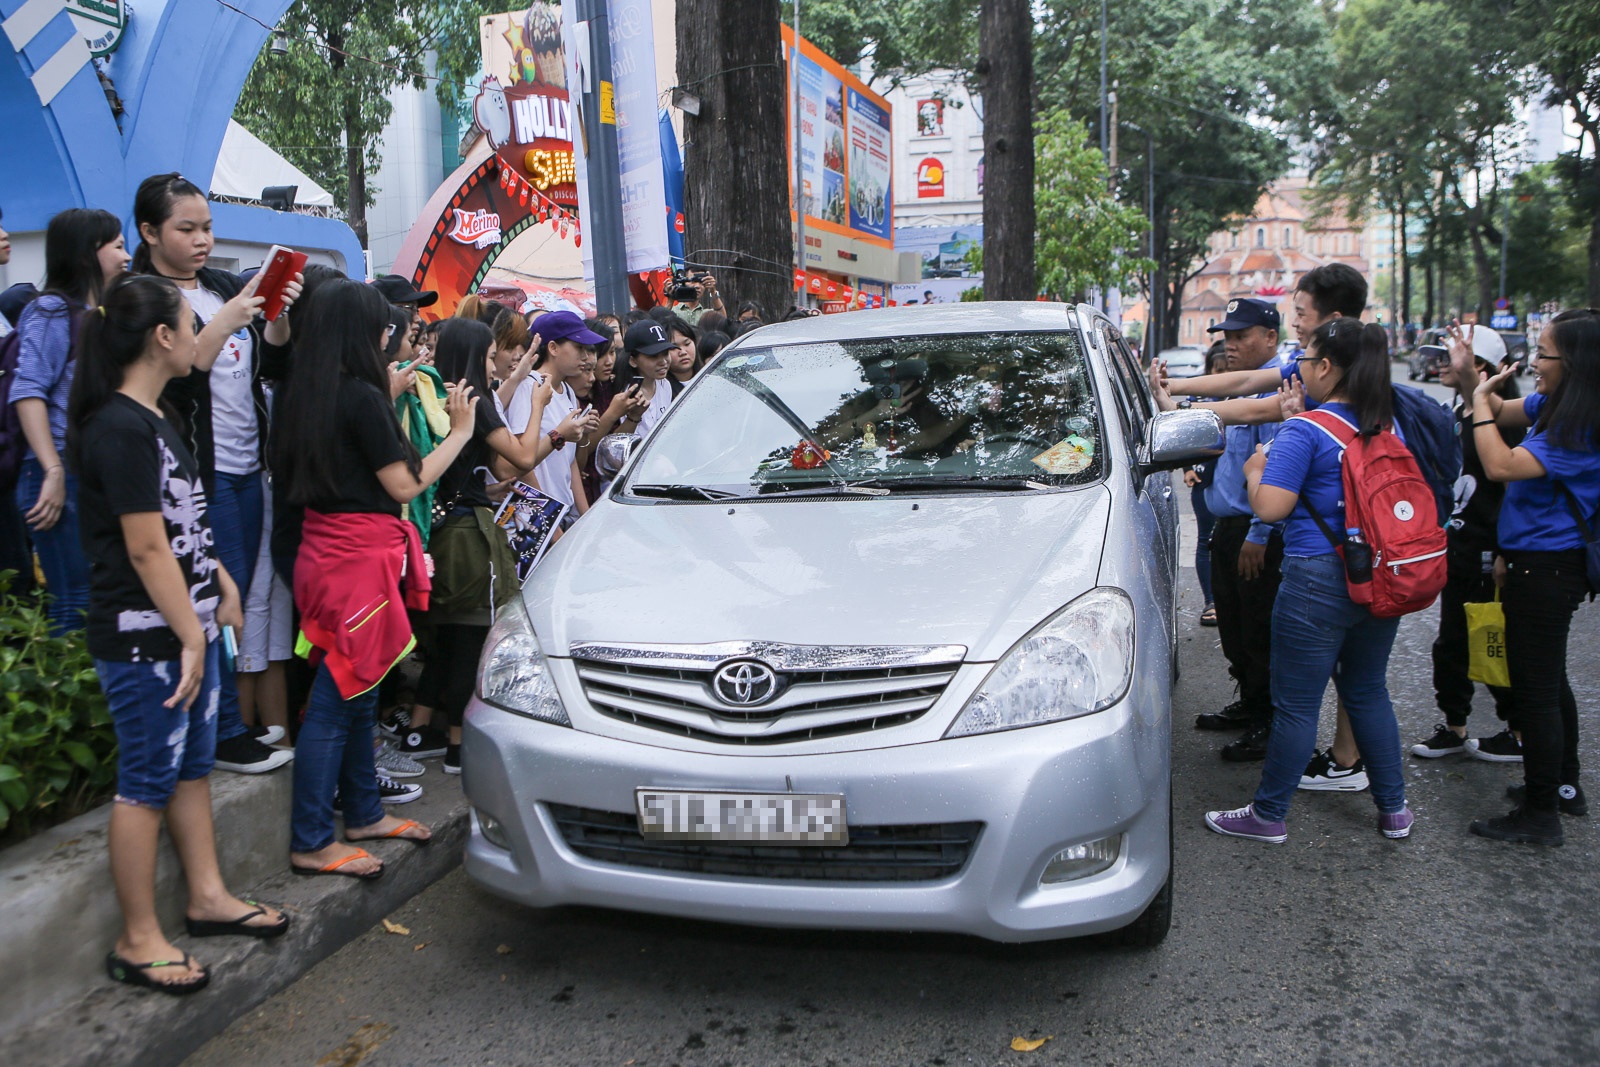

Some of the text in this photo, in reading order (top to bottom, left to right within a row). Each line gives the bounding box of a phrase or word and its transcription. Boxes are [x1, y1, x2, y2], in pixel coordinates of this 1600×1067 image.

[458, 210, 499, 235] Merino
[825, 304, 846, 313] ATM
[649, 325, 666, 342] T
